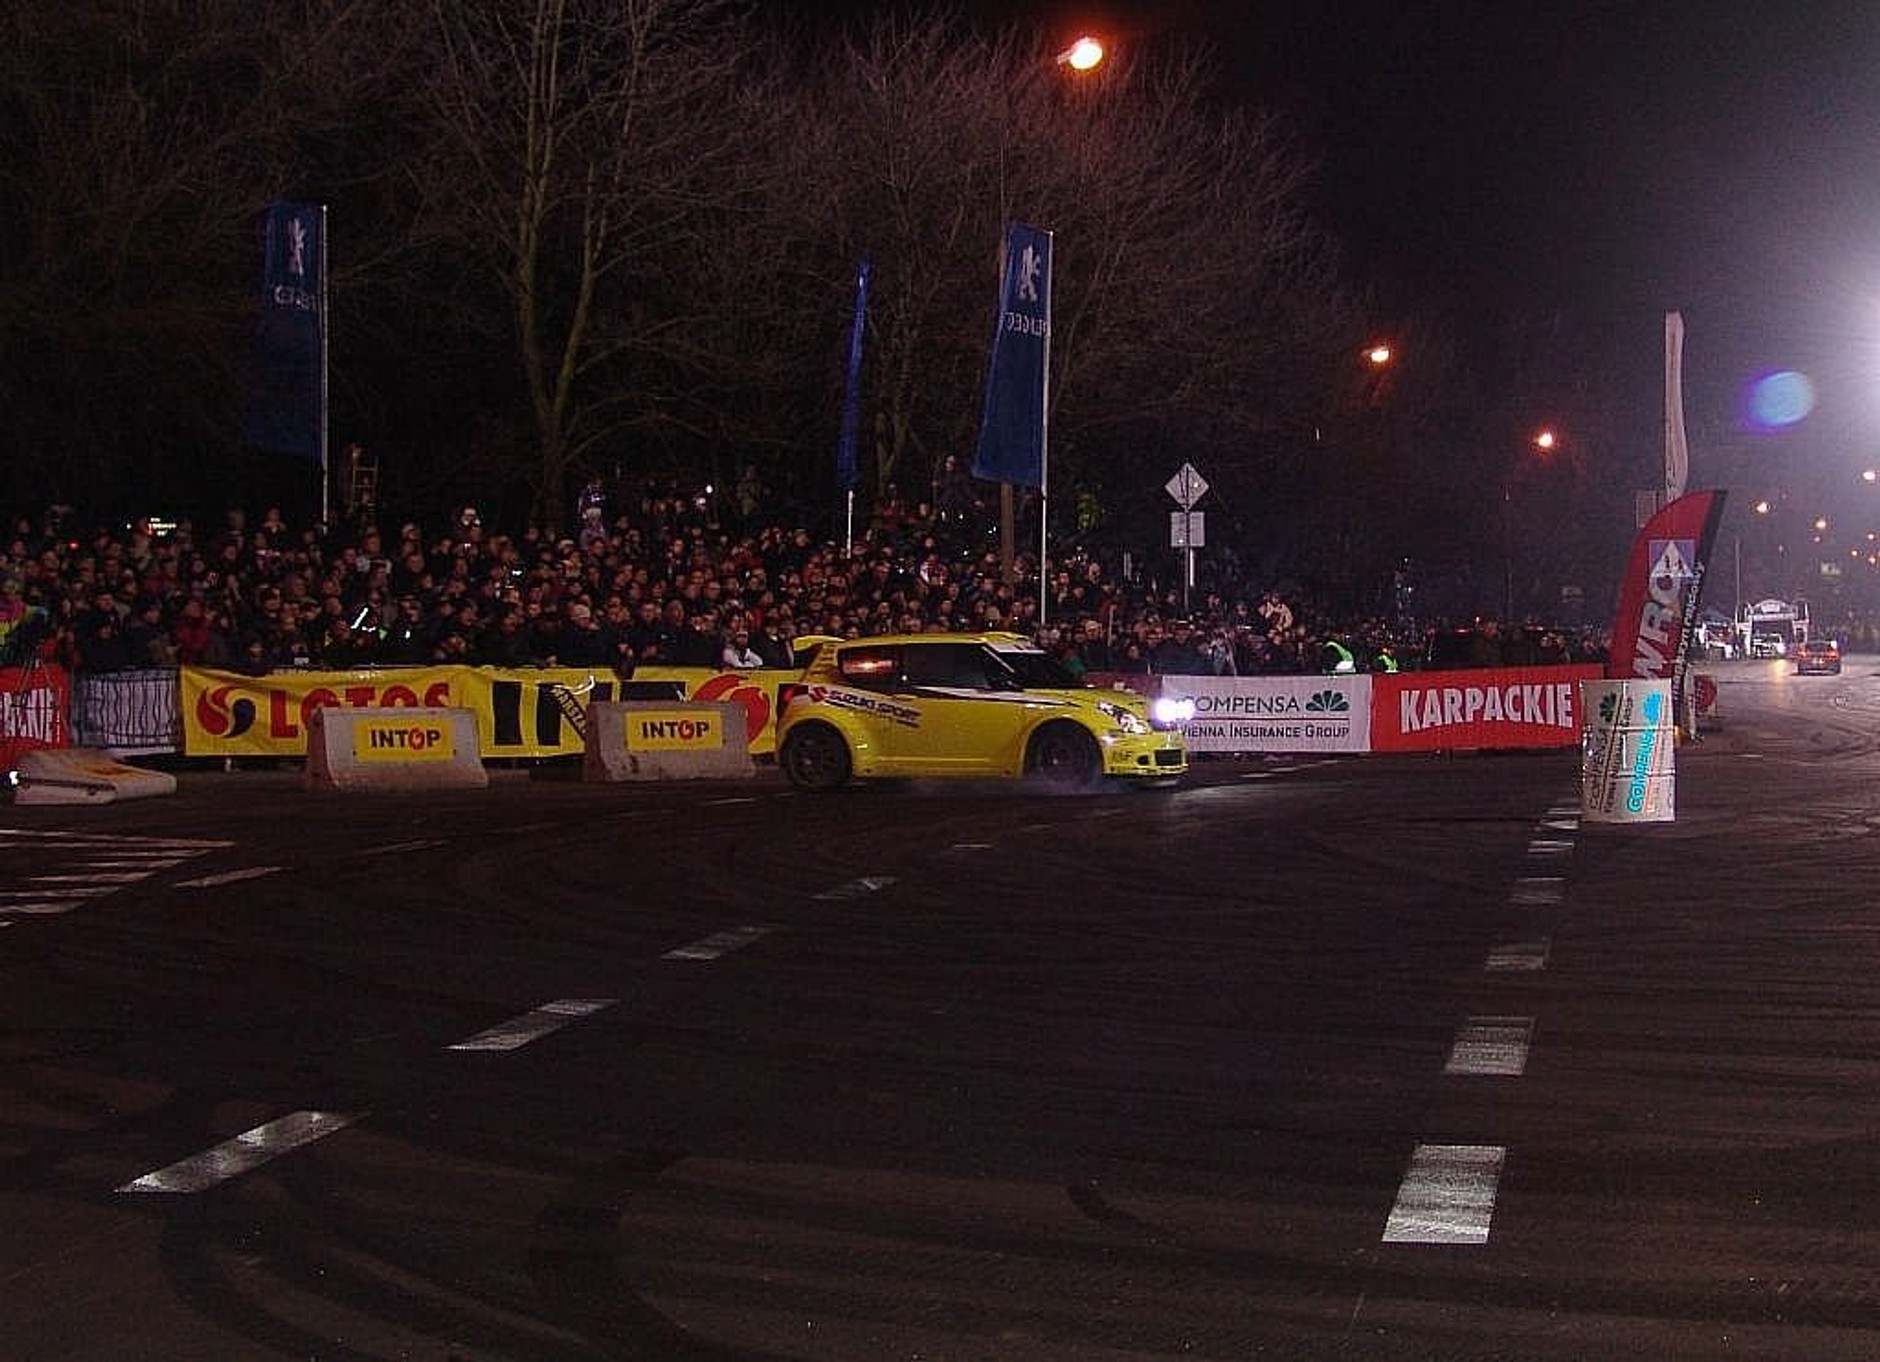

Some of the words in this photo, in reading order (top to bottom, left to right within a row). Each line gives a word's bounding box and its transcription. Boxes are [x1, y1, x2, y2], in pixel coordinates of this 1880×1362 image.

[1400, 683, 1573, 734] KARPACKIE
[370, 728, 441, 750] INTOP
[642, 719, 710, 740] INTOP
[1230, 723, 1301, 738] INSURANCE
[1305, 724, 1349, 738] GROUP
